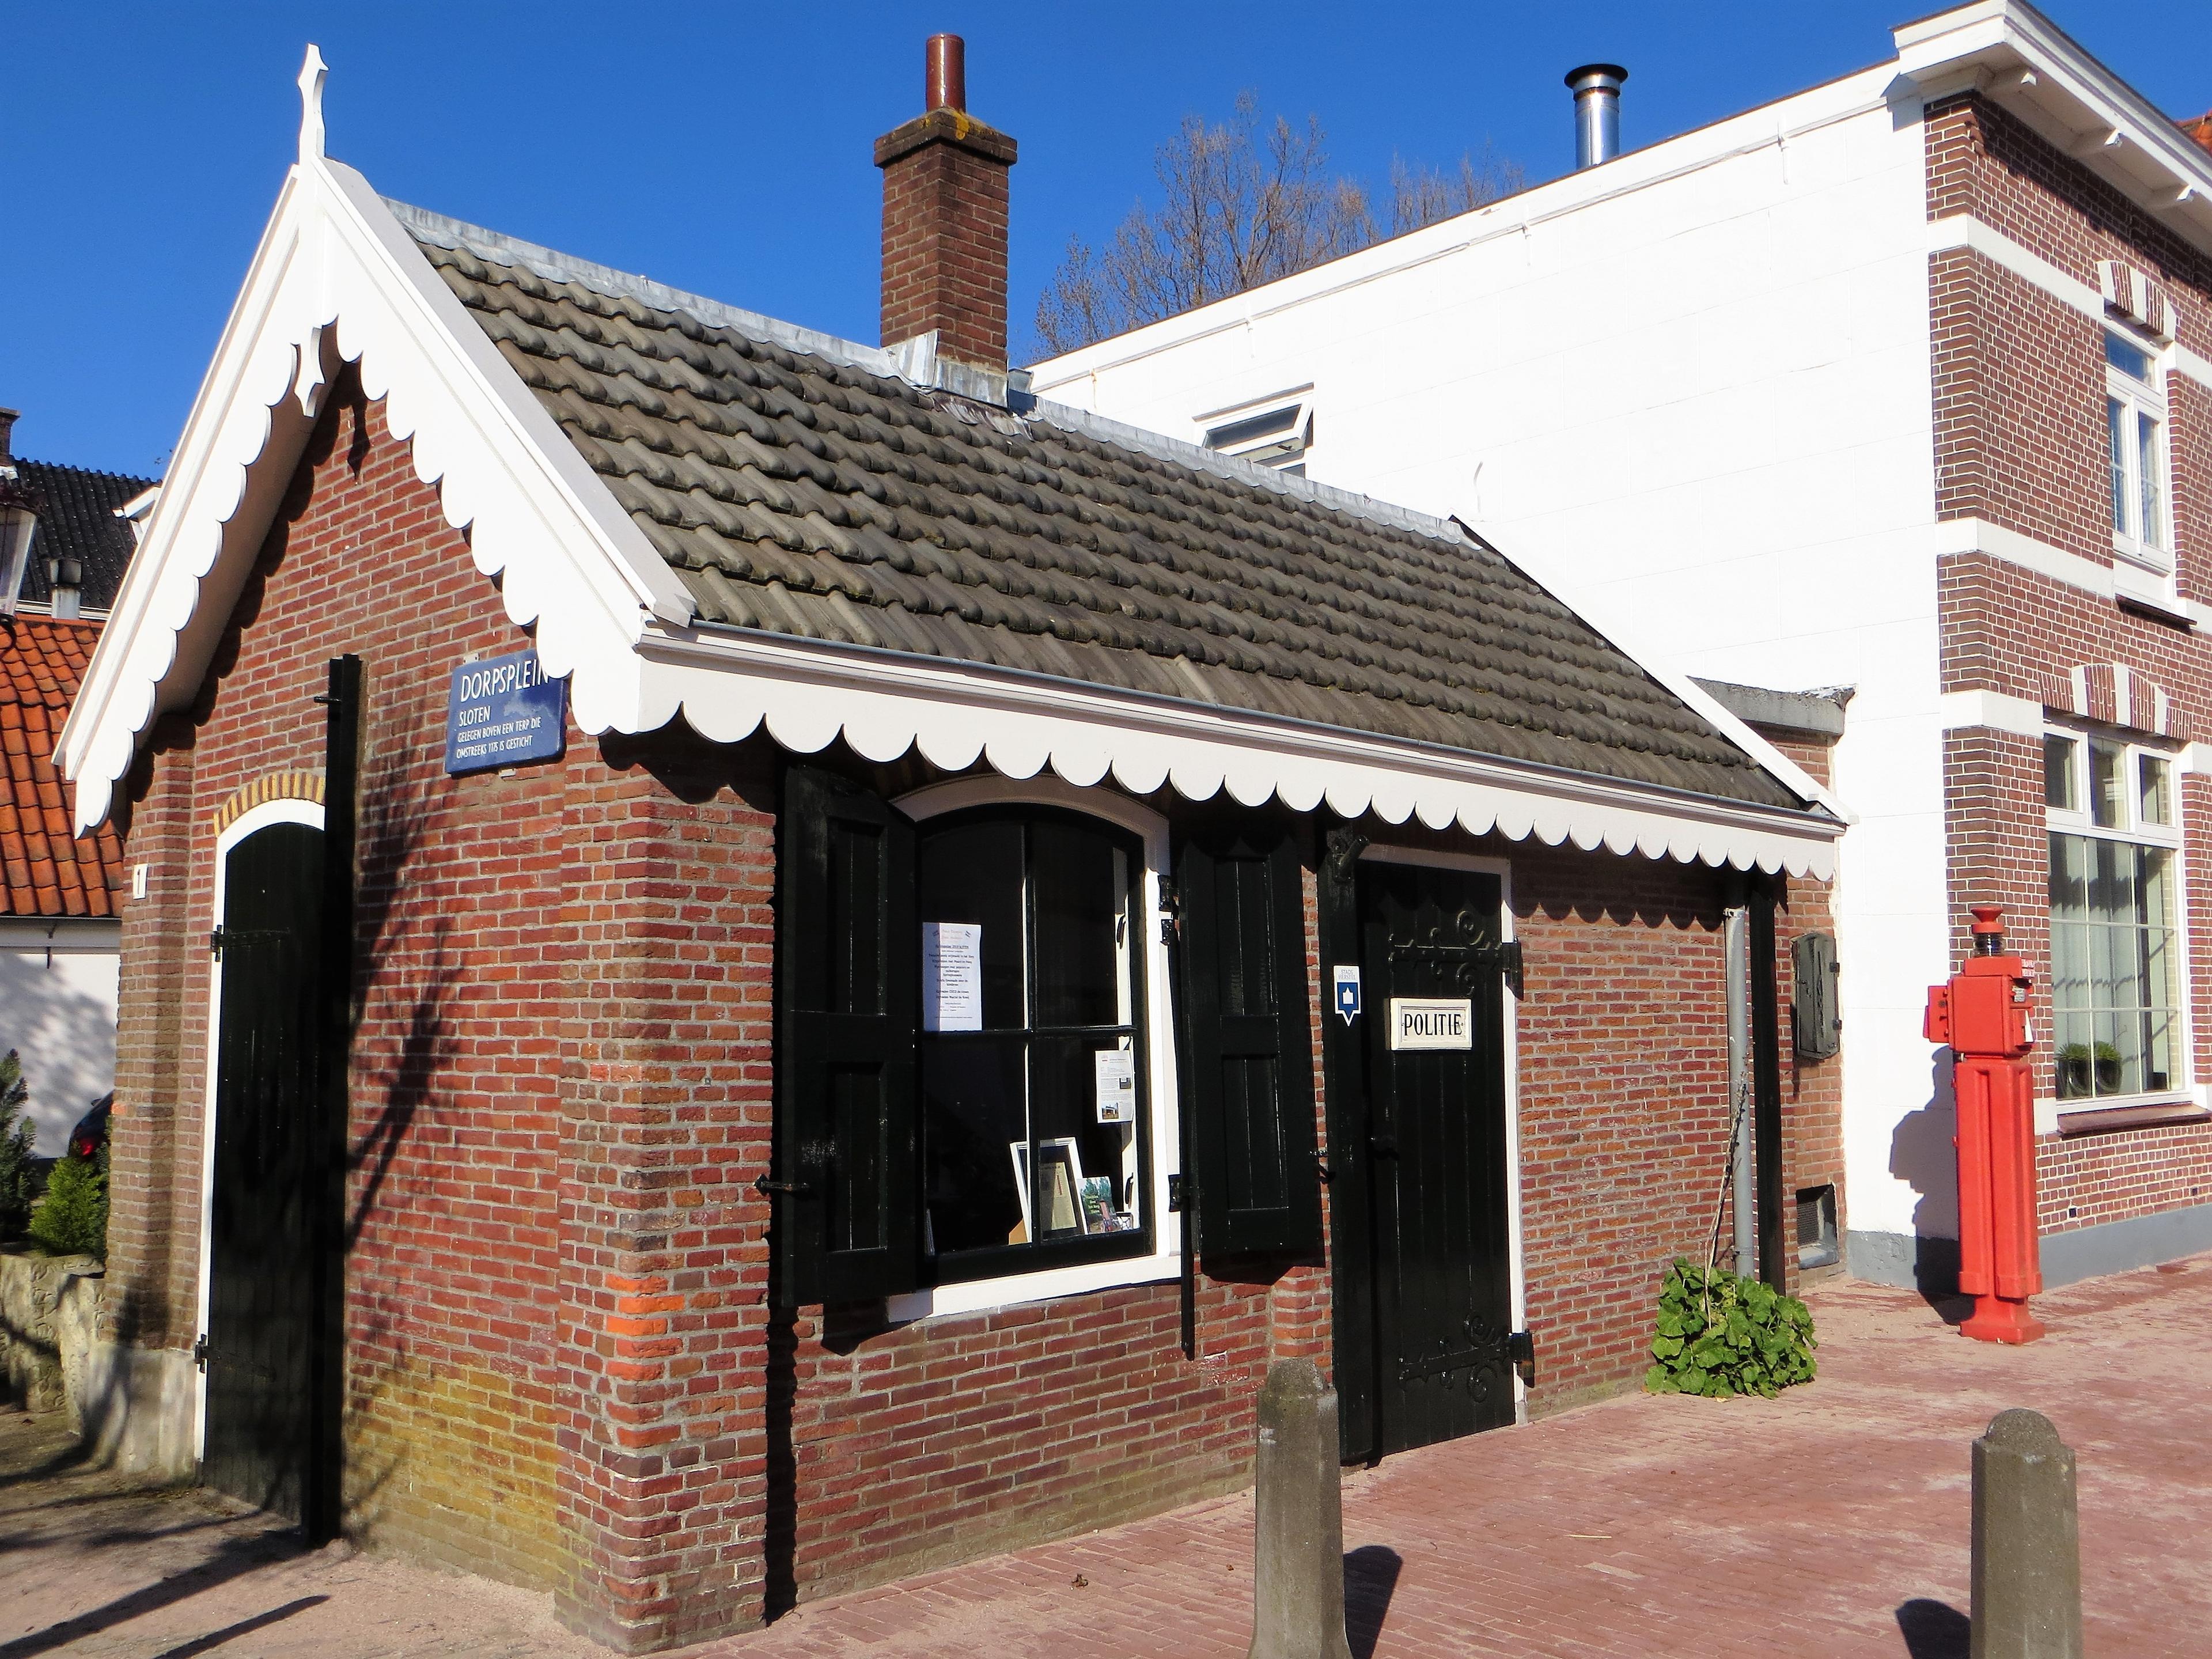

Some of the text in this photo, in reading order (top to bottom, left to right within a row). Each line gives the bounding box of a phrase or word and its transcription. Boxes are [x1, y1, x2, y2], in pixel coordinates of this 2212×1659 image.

[461, 659, 548, 702] DORPSPLEIN
[459, 706, 491, 727] SLOTEN
[457, 717, 541, 743] GELEGEN BOVEN EEN TERP DIE
[456, 744, 487, 759] OMSTREEKS
[499, 740, 505, 751] IS
[506, 735, 533, 749] GESTICHT
[1404, 1013, 1463, 1036] POLITIE
